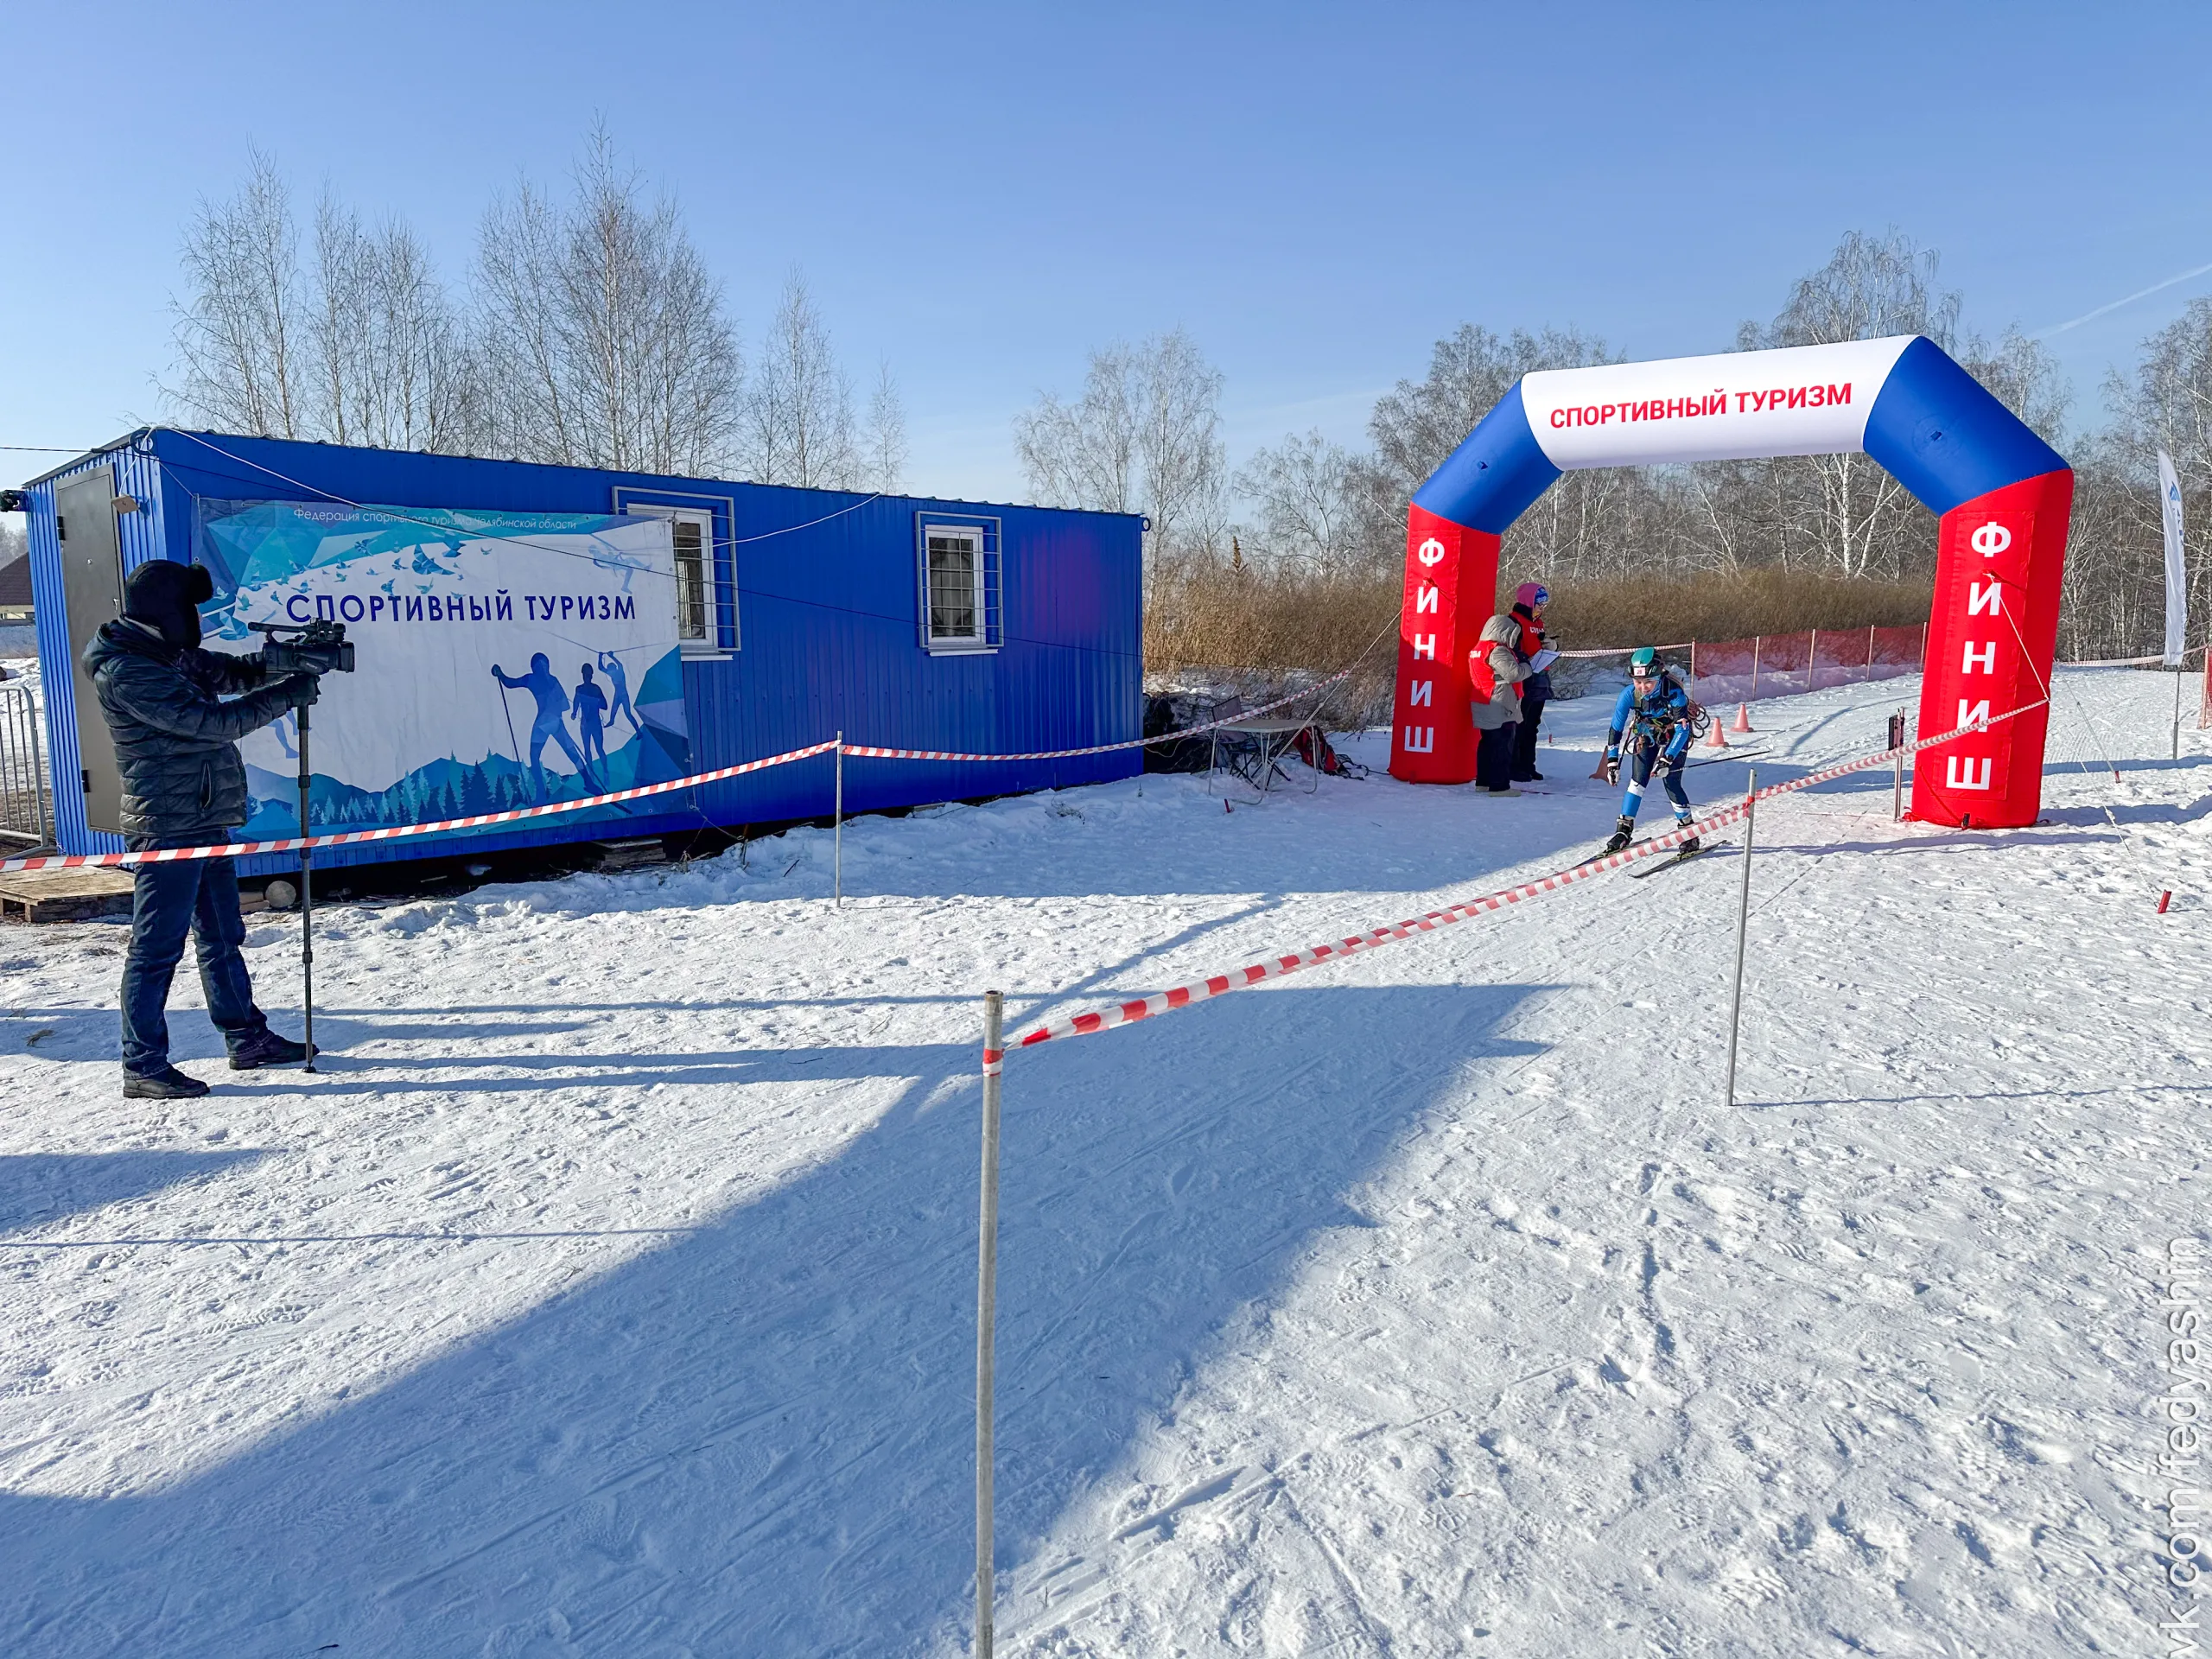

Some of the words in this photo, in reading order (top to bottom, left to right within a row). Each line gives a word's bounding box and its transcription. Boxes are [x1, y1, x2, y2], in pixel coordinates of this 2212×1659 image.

[1550, 388, 1726, 429] СПОРТИВНЫЙ
[1735, 383, 1852, 413] ТУРИЗМ
[294, 508, 359, 523] Федерация
[538, 518, 576, 530] области
[286, 589, 513, 622] СПОРТИВНЫЙ
[524, 595, 636, 620] ТУРИЗМ
[1404, 537, 1445, 753] ФИНИШ
[1946, 521, 2012, 790] ФИНИШ
